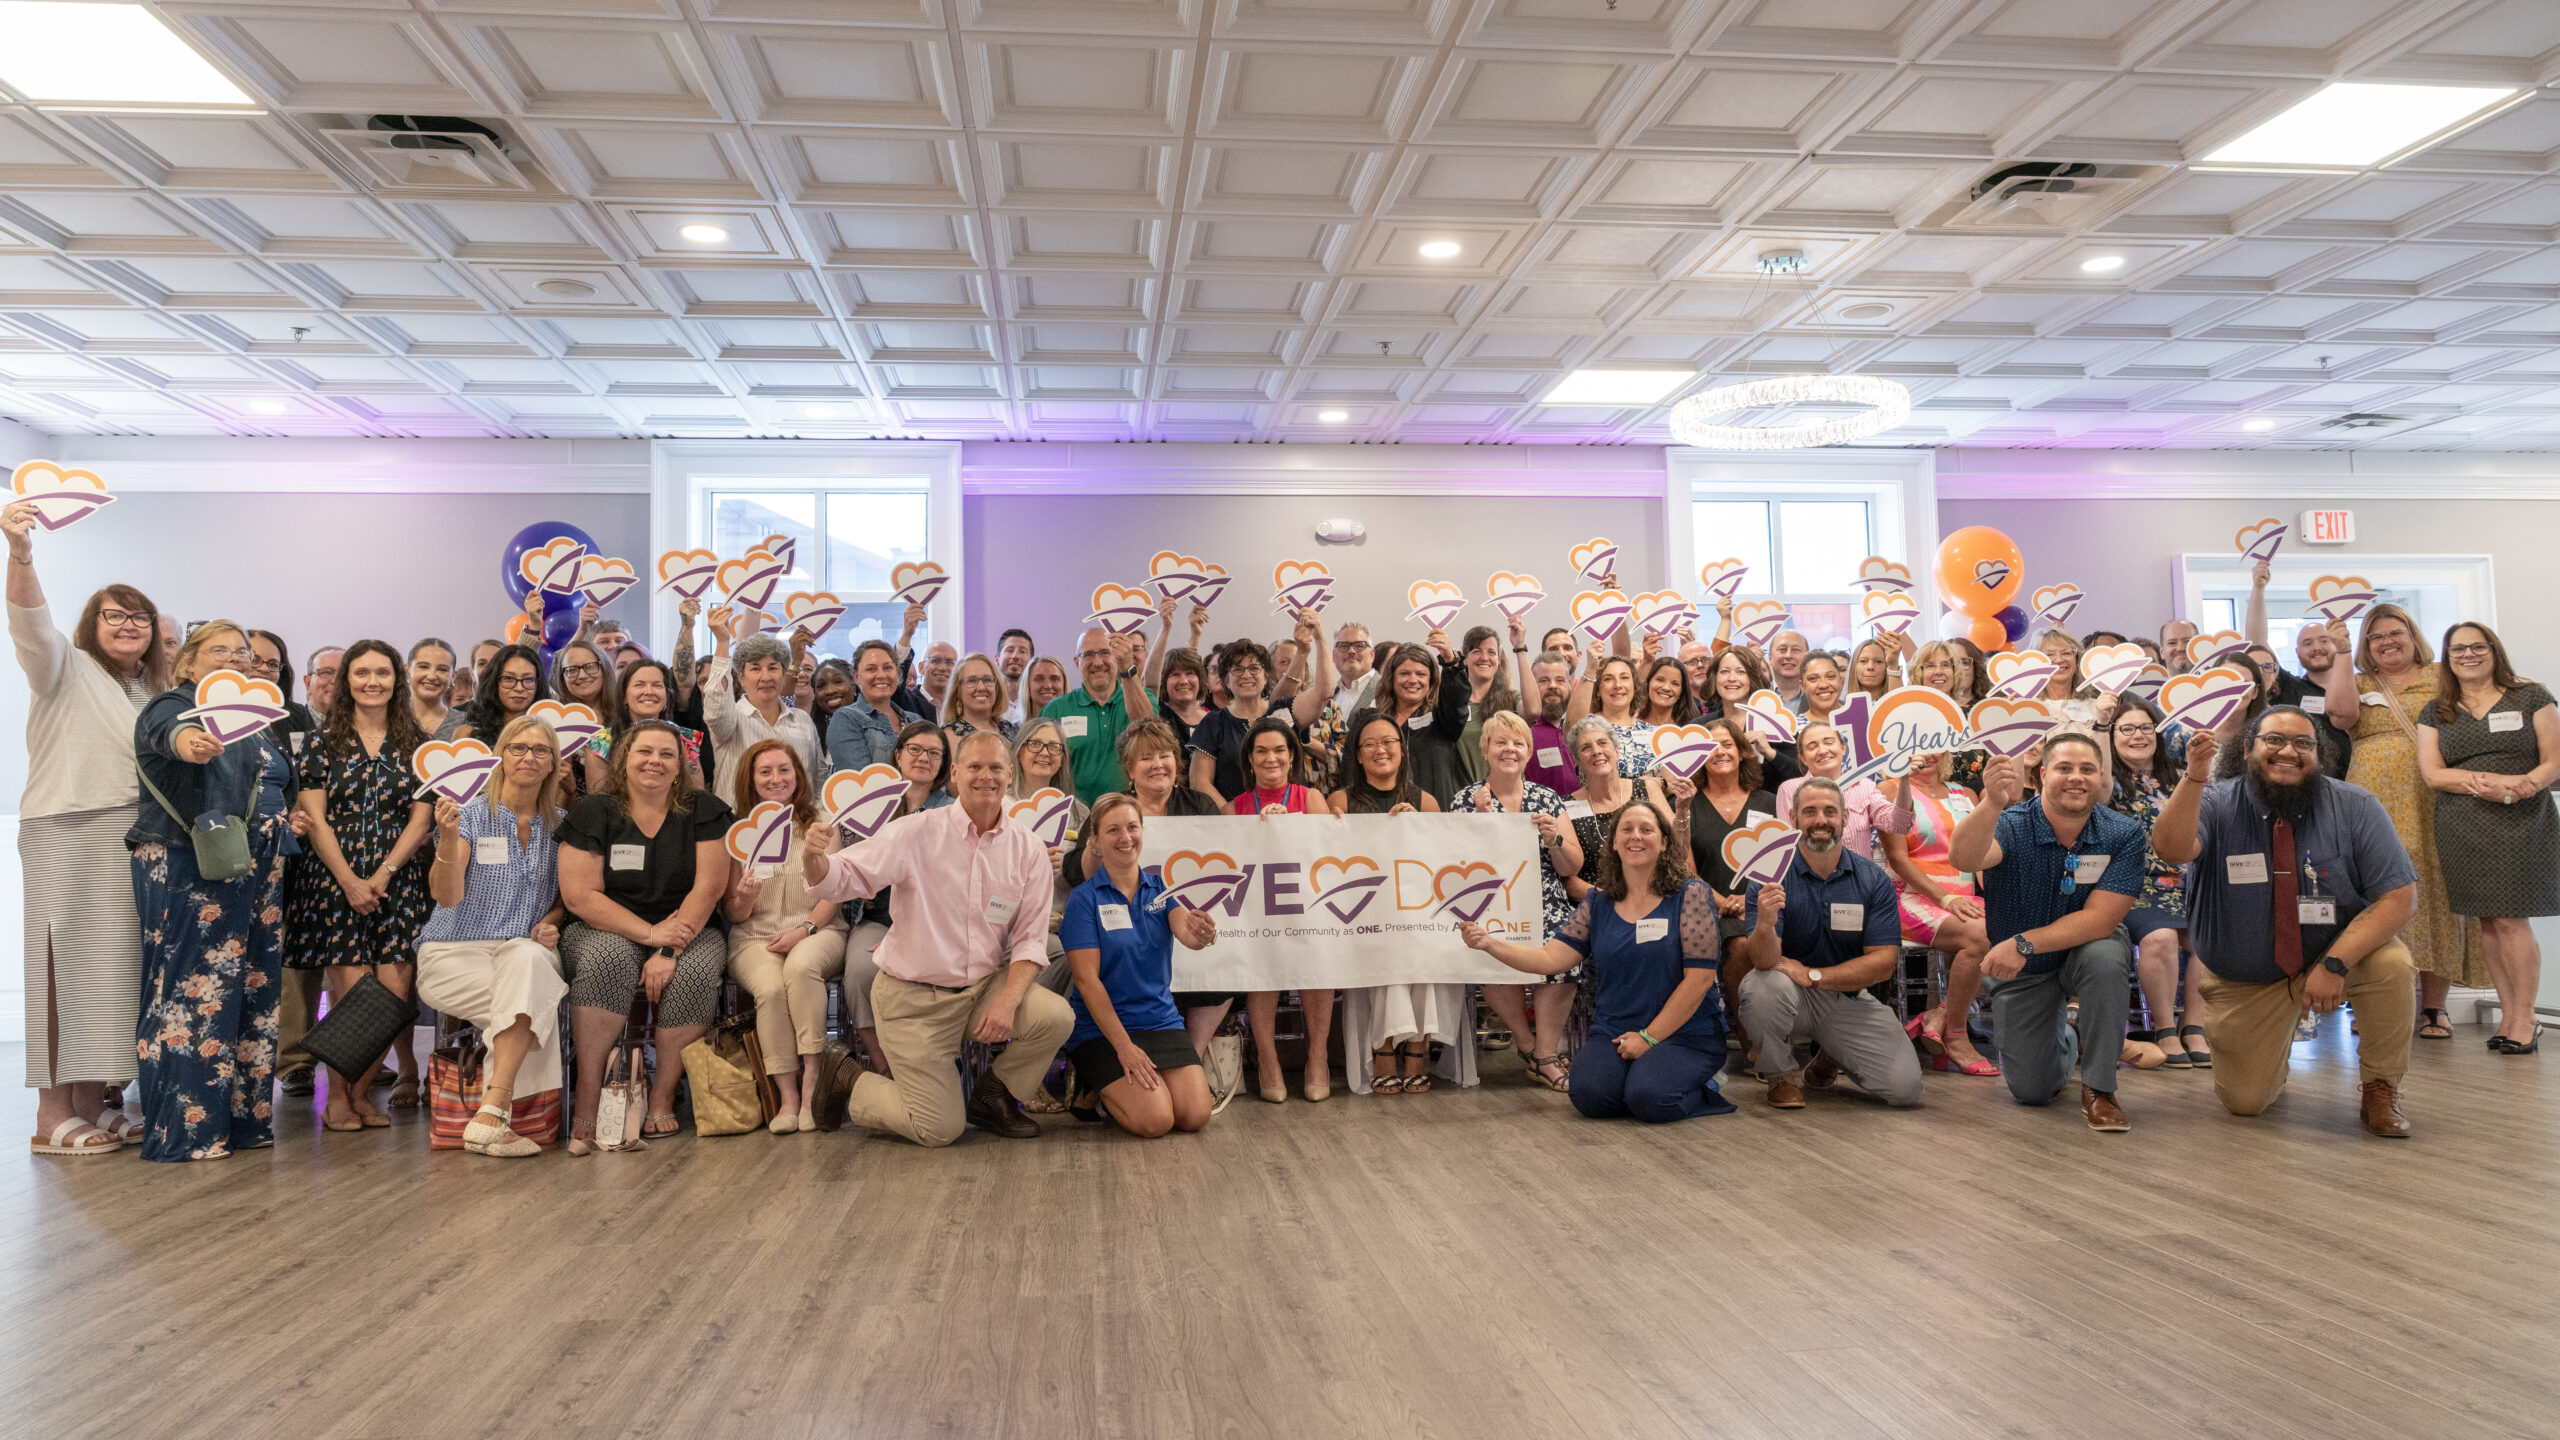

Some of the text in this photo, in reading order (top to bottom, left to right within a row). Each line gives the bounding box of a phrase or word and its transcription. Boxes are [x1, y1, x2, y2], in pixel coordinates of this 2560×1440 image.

[2315, 512, 2348, 540] EXIT
[1249, 928, 1259, 938] of
[1262, 928, 1281, 938] Our
[1284, 927, 1340, 938] Community
[1343, 927, 1354, 935] as
[1356, 924, 1382, 935] ONE.
[1385, 922, 1435, 932] Presented
[1437, 922, 1449, 933] by
